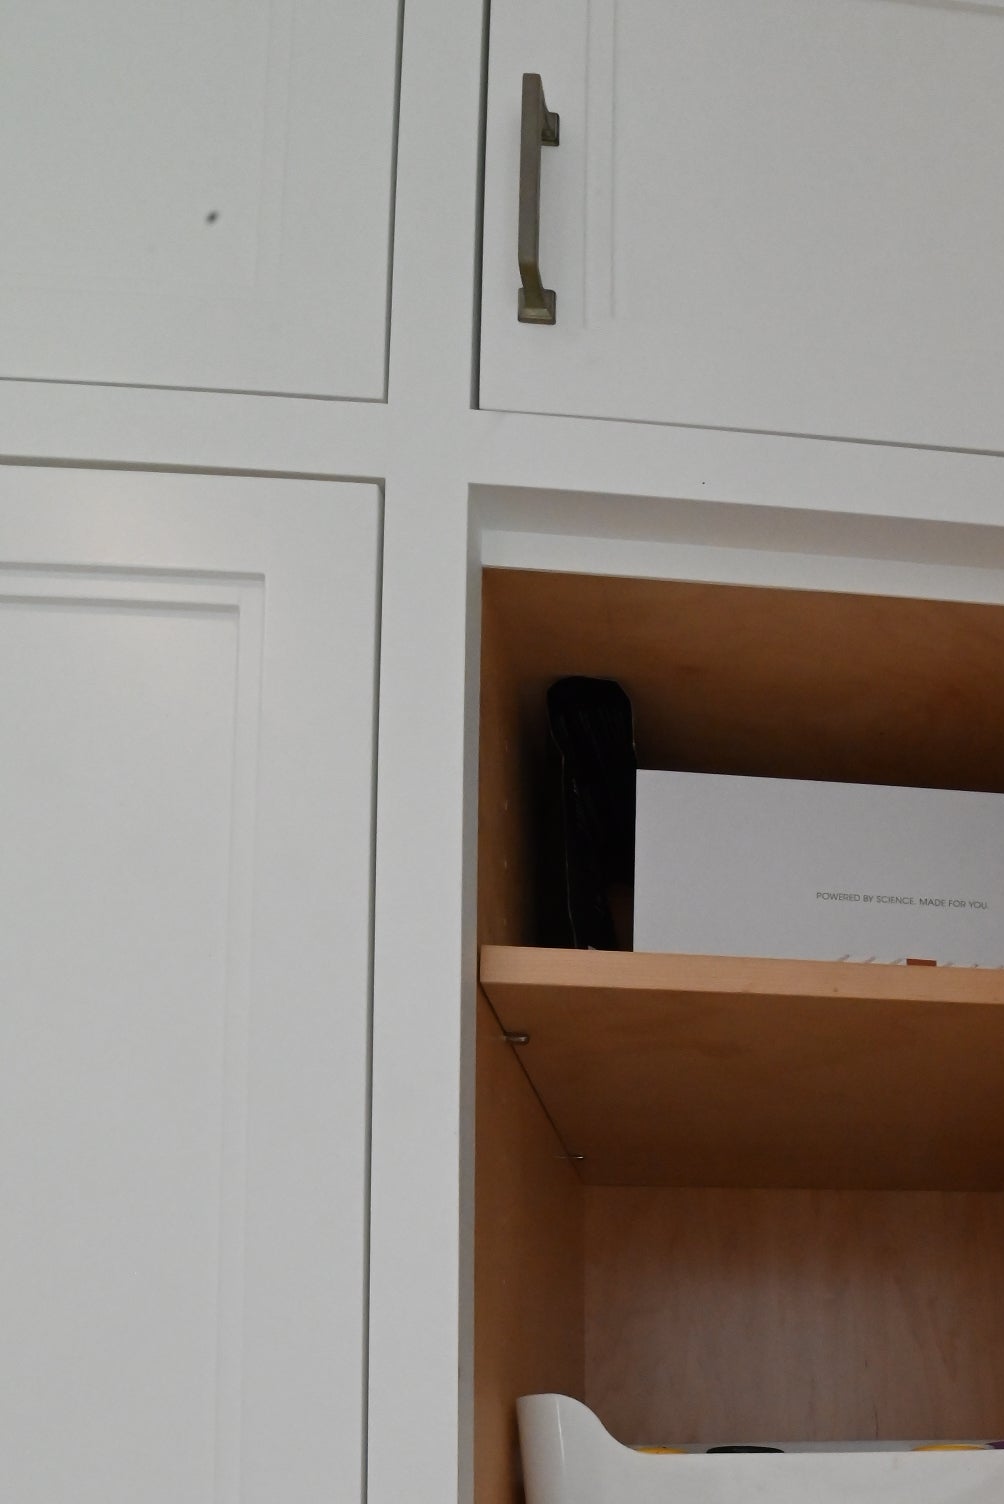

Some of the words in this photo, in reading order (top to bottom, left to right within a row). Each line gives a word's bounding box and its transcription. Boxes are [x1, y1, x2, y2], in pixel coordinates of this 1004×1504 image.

[816, 891, 861, 902] POWERED
[863, 894, 874, 903] BY
[919, 897, 946, 907] MADE
[948, 899, 967, 908] FOR
